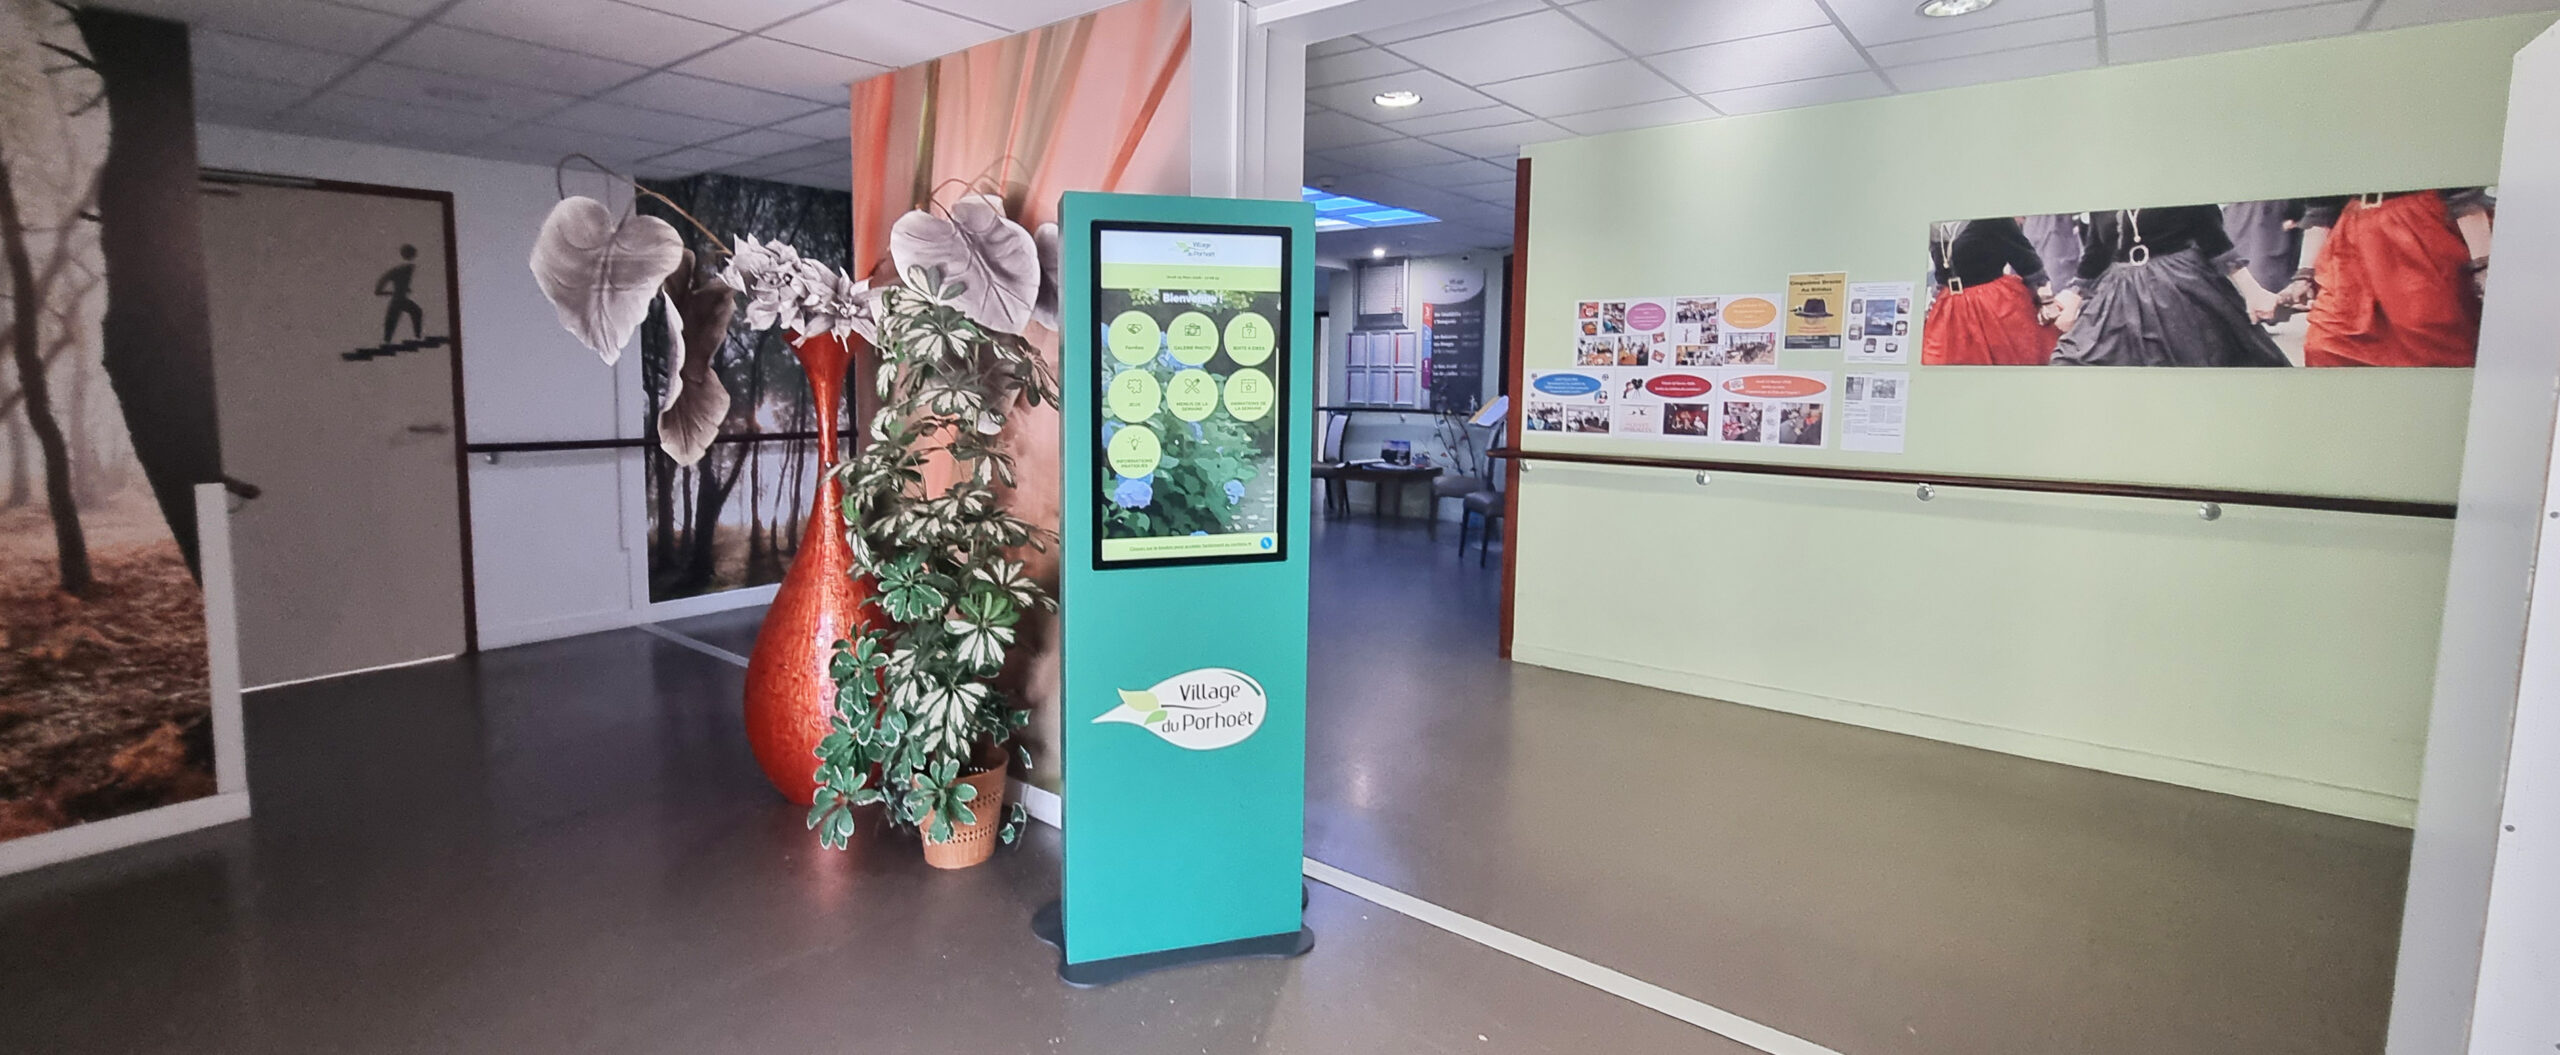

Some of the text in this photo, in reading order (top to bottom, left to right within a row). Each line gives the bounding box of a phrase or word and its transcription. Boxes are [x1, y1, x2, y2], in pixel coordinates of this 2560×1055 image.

[1162, 293, 1218, 304] Bienvenue
[1179, 683, 1241, 704] Village
[1161, 711, 1254, 733] du Porhoët
